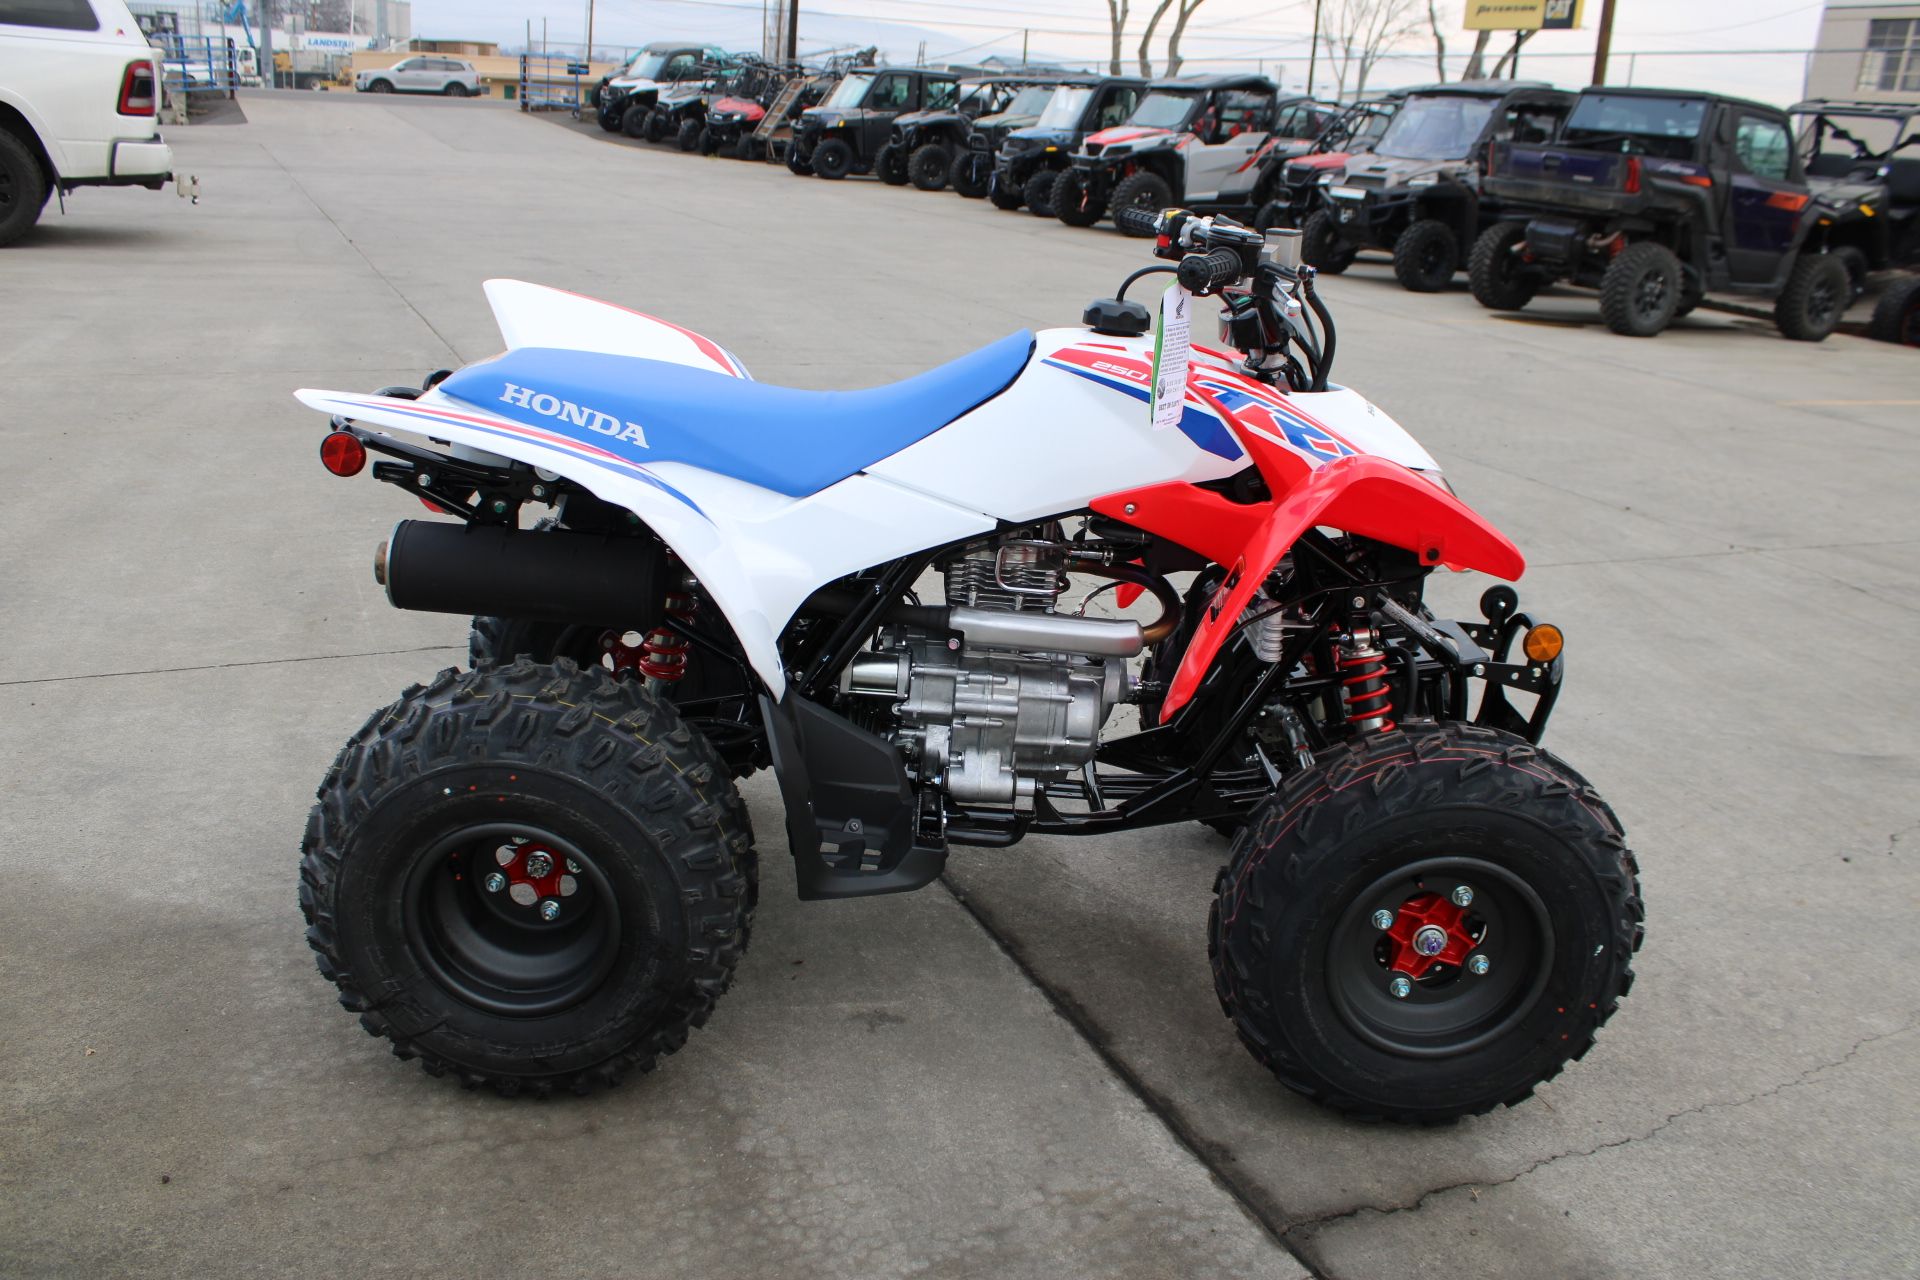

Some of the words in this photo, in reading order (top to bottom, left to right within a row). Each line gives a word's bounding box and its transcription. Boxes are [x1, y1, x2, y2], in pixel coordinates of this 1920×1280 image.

[1544, 0, 1573, 19] CAT
[1090, 360, 1149, 381] 250
[498, 382, 650, 450] HONDA
